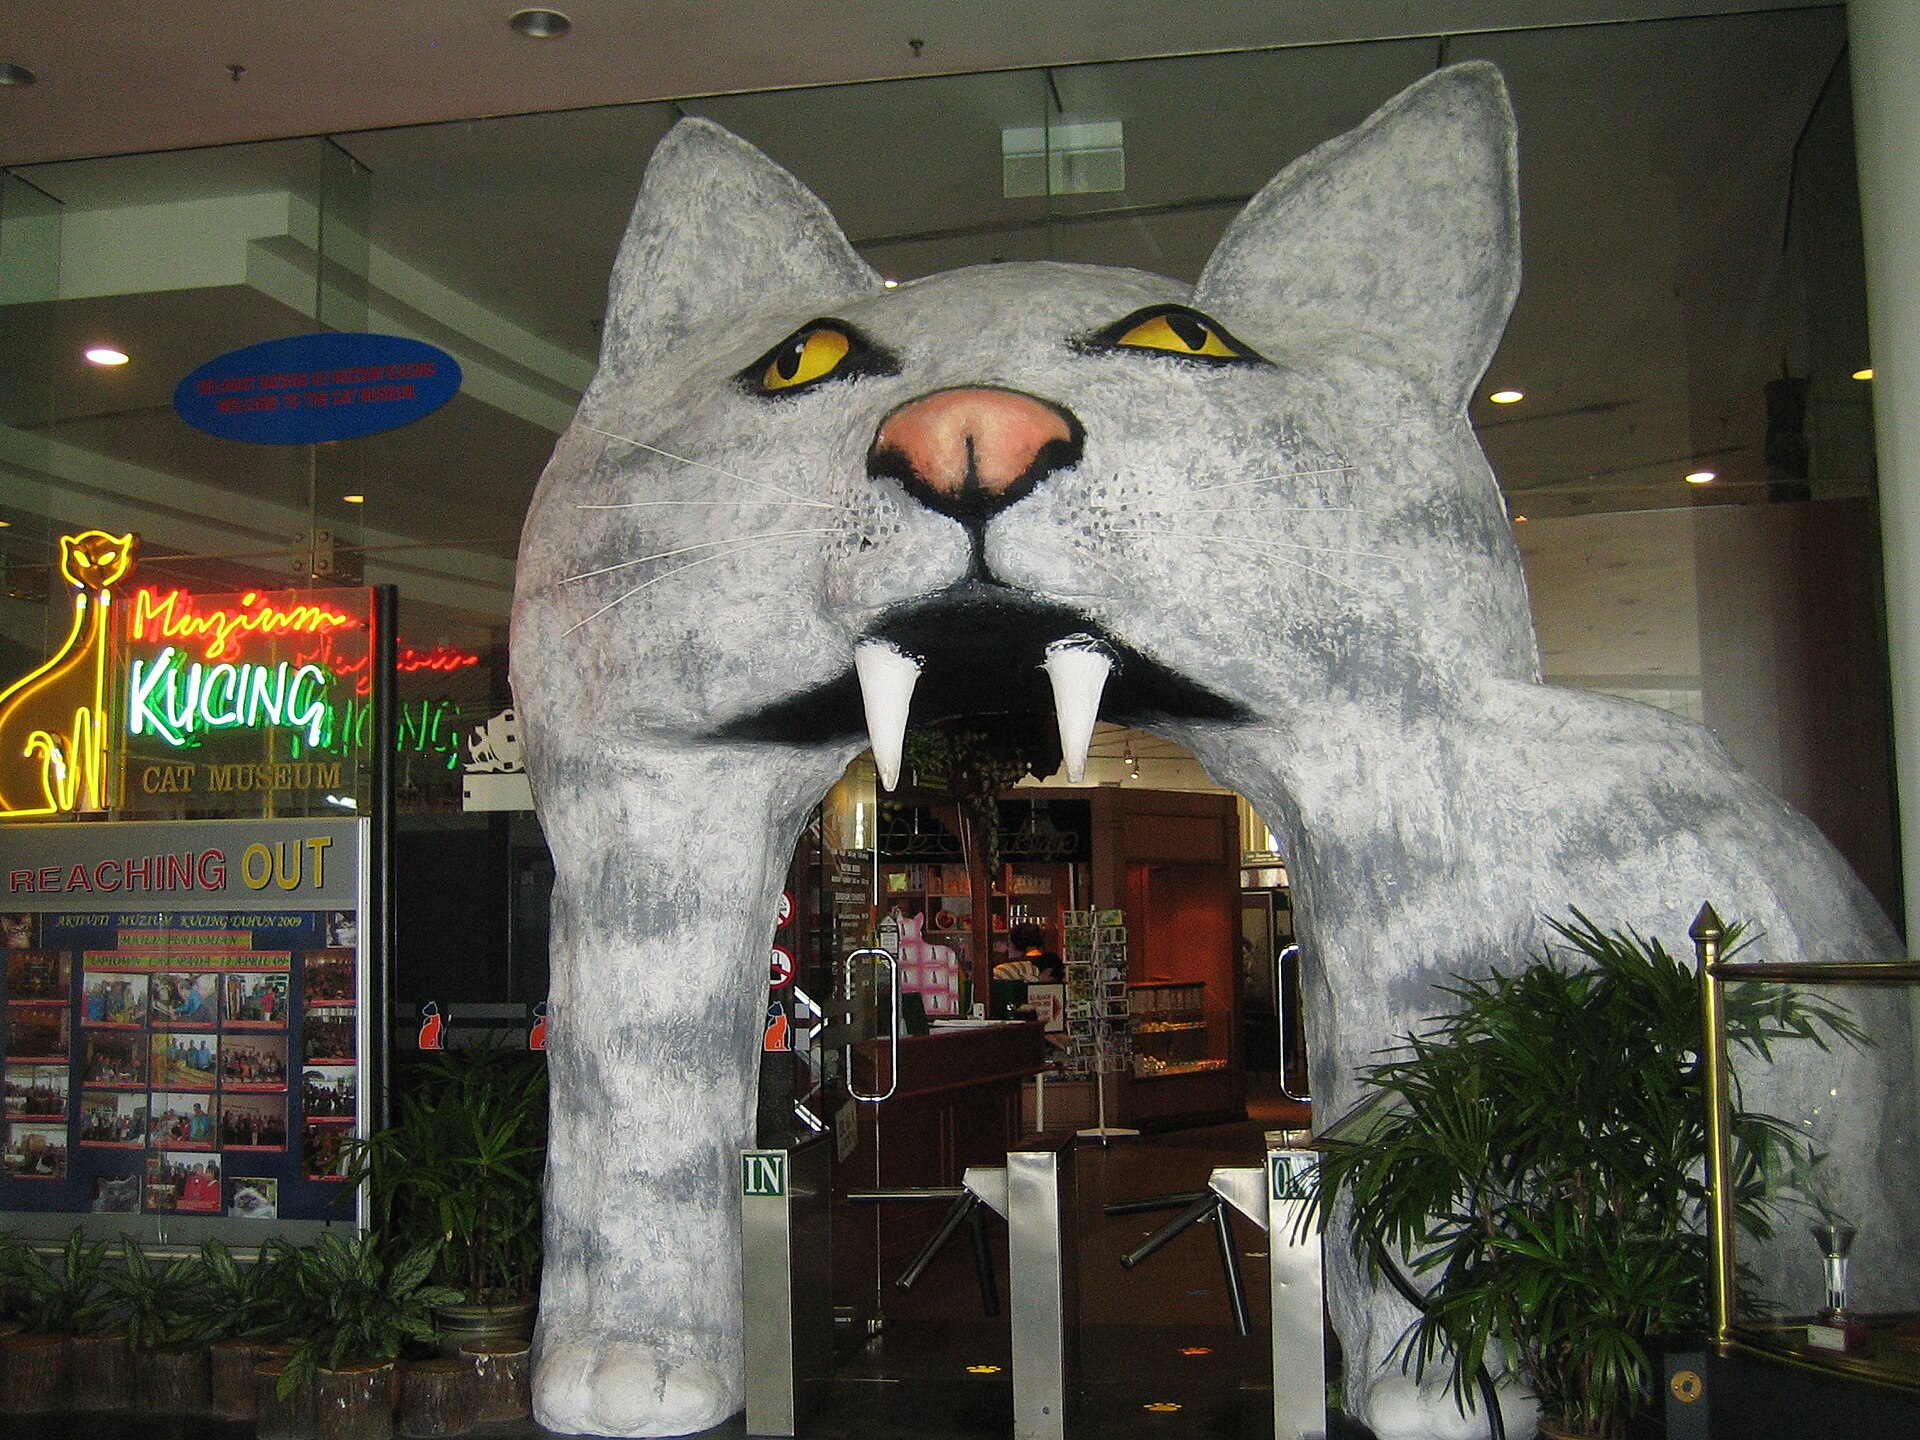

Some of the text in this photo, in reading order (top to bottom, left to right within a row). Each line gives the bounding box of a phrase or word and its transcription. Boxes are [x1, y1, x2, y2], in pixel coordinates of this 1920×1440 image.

[130, 645, 327, 748] KUCING
[143, 762, 342, 795] CAT MUSEUM
[8, 836, 333, 893] REACHING OUT
[180, 915, 228, 930] KUCING
[229, 916, 276, 928] TAHUN
[277, 916, 303, 928] 2009
[745, 1156, 784, 1194] IN
